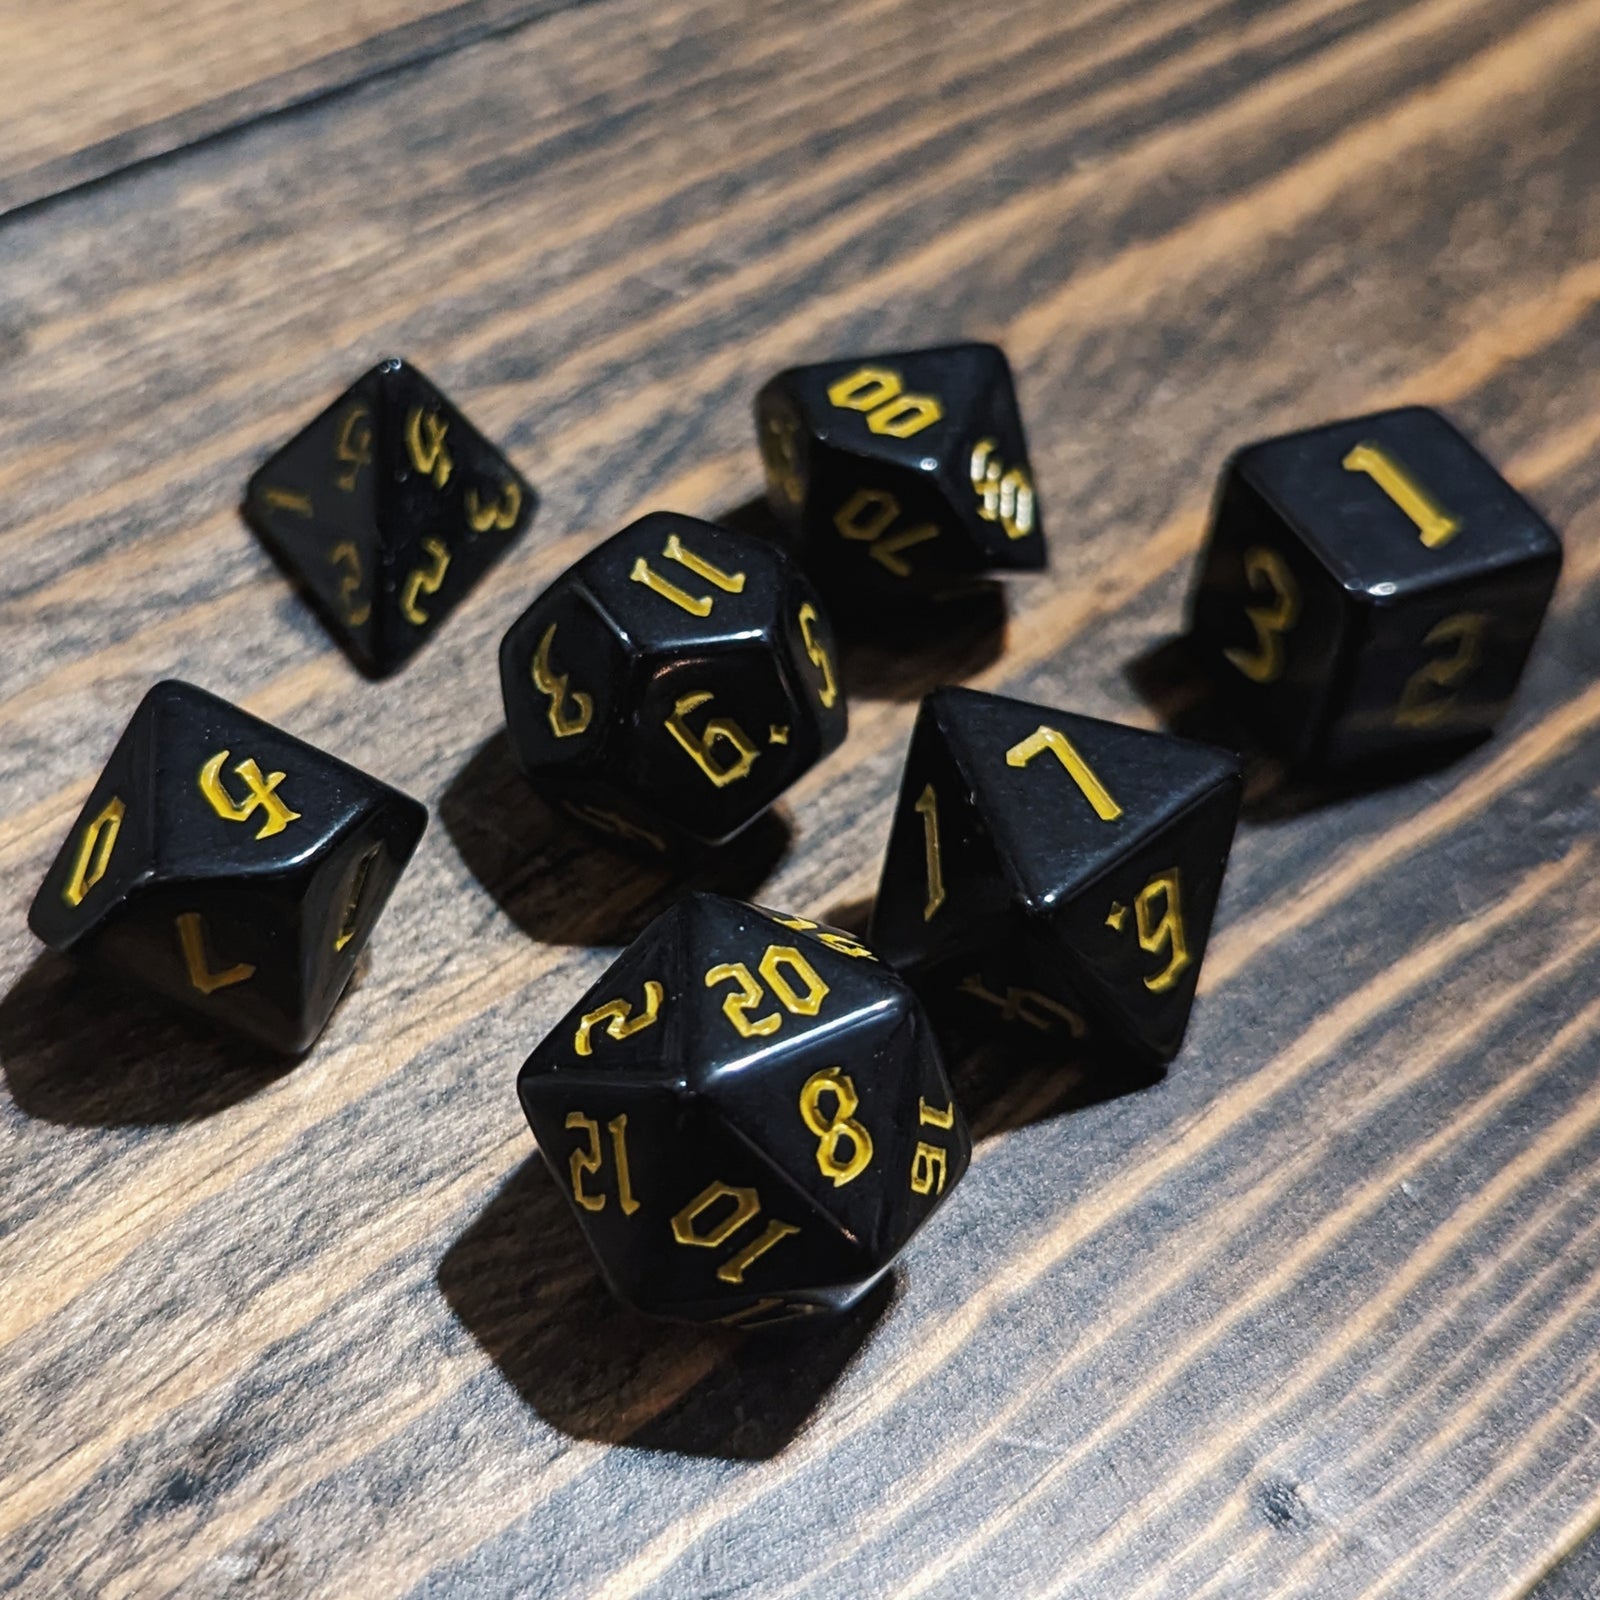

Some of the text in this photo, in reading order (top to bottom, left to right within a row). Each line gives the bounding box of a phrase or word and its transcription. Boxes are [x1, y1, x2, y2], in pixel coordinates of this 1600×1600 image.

[826, 364, 944, 439] 00
[405, 405, 454, 490] 4
[464, 481, 522, 534] 3
[832, 487, 941, 577] 70
[1341, 440, 1462, 548] 1
[403, 535, 452, 626] 2
[629, 533, 747, 617] 11
[1222, 545, 1299, 684] 3
[1393, 612, 1488, 728] 2
[199, 749, 302, 840] 4
[1005, 725, 1124, 821] 7
[914, 782, 947, 923] 1
[175, 911, 256, 995] 7
[704, 944, 831, 1038] 20
[574, 980, 664, 1056] 2
[798, 1065, 875, 1188] 8
[670, 1178, 801, 1286] 10
